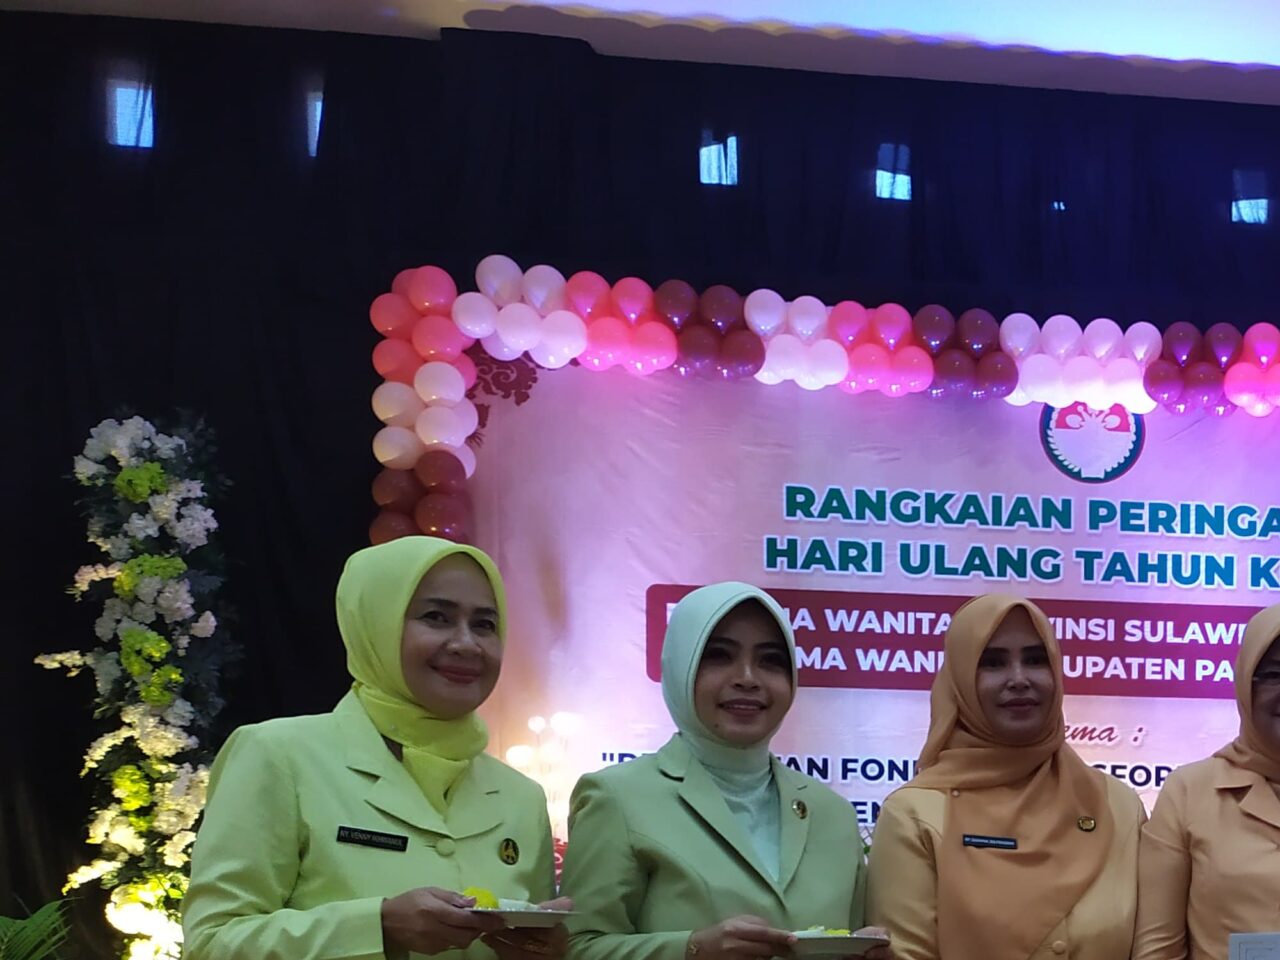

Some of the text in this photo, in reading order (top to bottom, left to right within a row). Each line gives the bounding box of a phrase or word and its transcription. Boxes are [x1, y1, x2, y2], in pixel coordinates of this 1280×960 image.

[784, 485, 1073, 530] RANGKAIAN
[765, 537, 883, 573] HARI
[899, 543, 1062, 580] ULANG
[1075, 550, 1235, 588] TAHUN
[824, 608, 952, 636] WANITA
[1123, 619, 1249, 646] SULAW
[855, 648, 945, 674] WANI
[1062, 655, 1186, 681] UPATEN
[1064, 723, 1119, 743] ema
